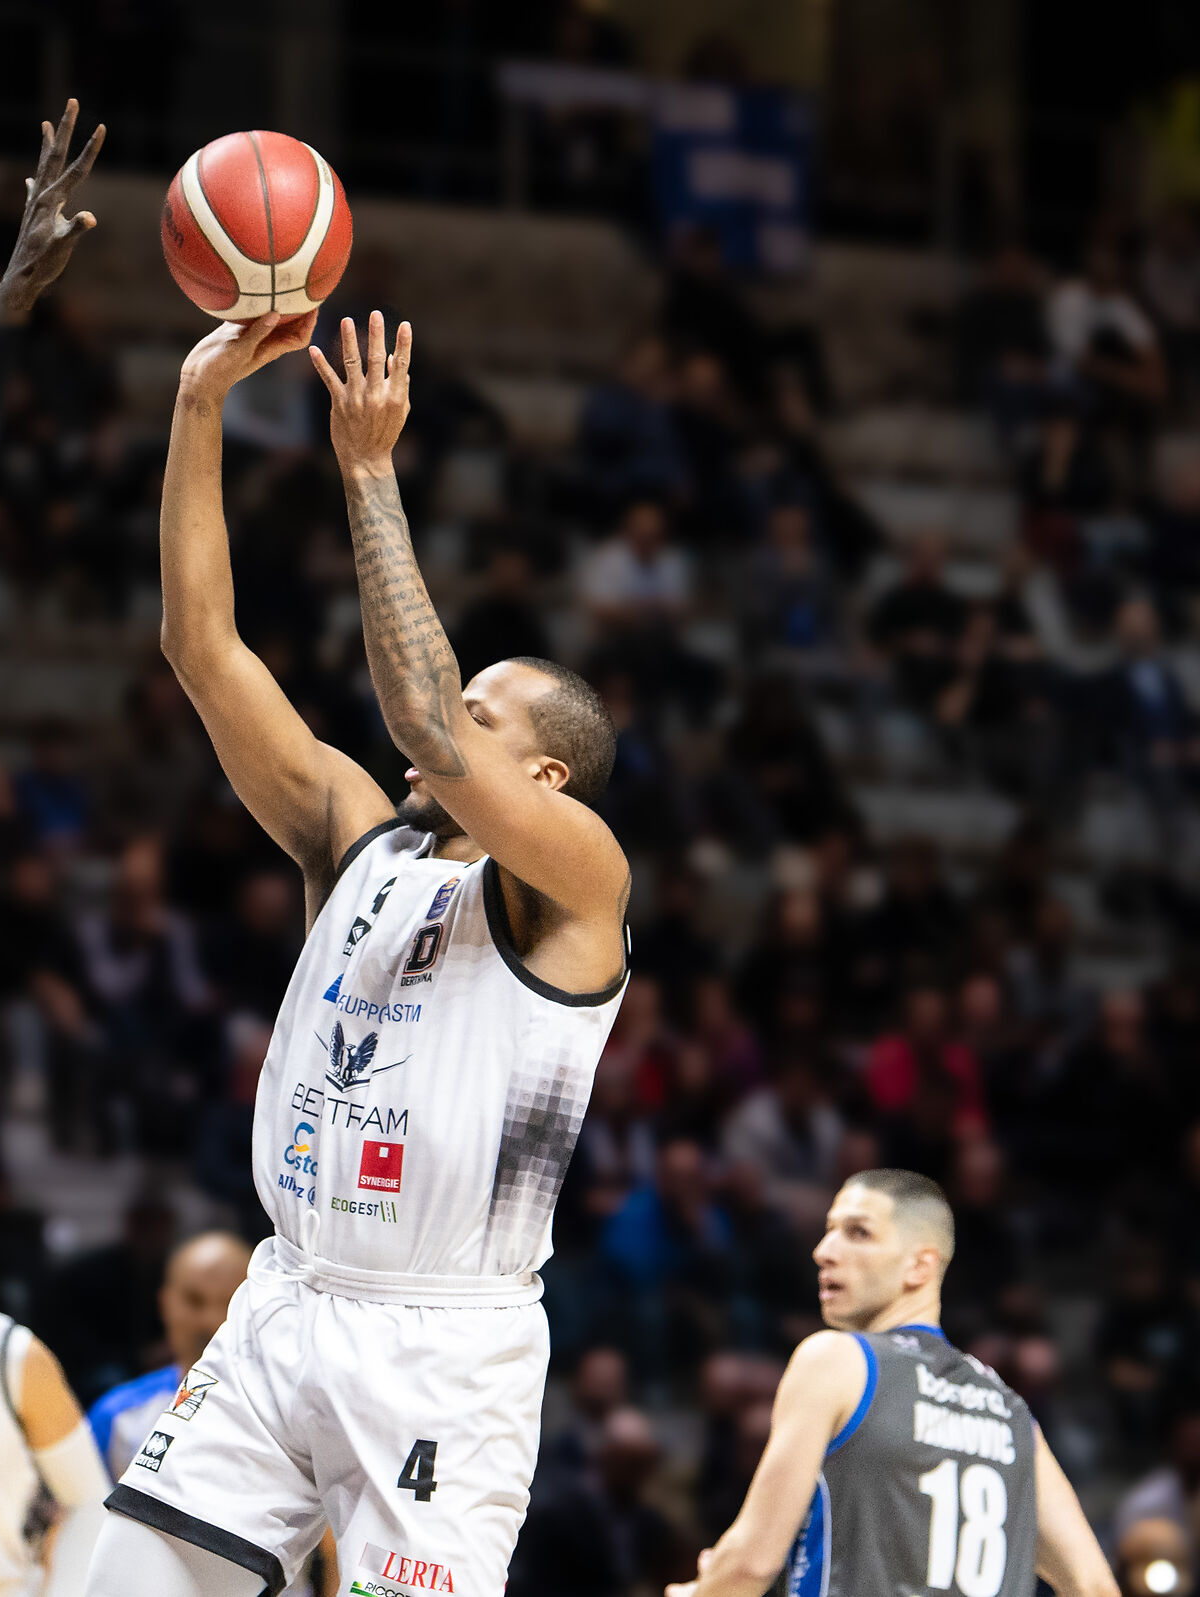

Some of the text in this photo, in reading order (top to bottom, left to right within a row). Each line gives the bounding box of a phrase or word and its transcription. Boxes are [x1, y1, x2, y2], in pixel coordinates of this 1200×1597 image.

[403, 922, 444, 975] D
[359, 1175, 400, 1189] SYNERGIE
[331, 1196, 379, 1217] ECOGEST
[397, 1439, 439, 1503] 4
[918, 1459, 1008, 1597] 18
[364, 1582, 413, 1597] RICCO
[381, 1551, 455, 1593] LERTA
